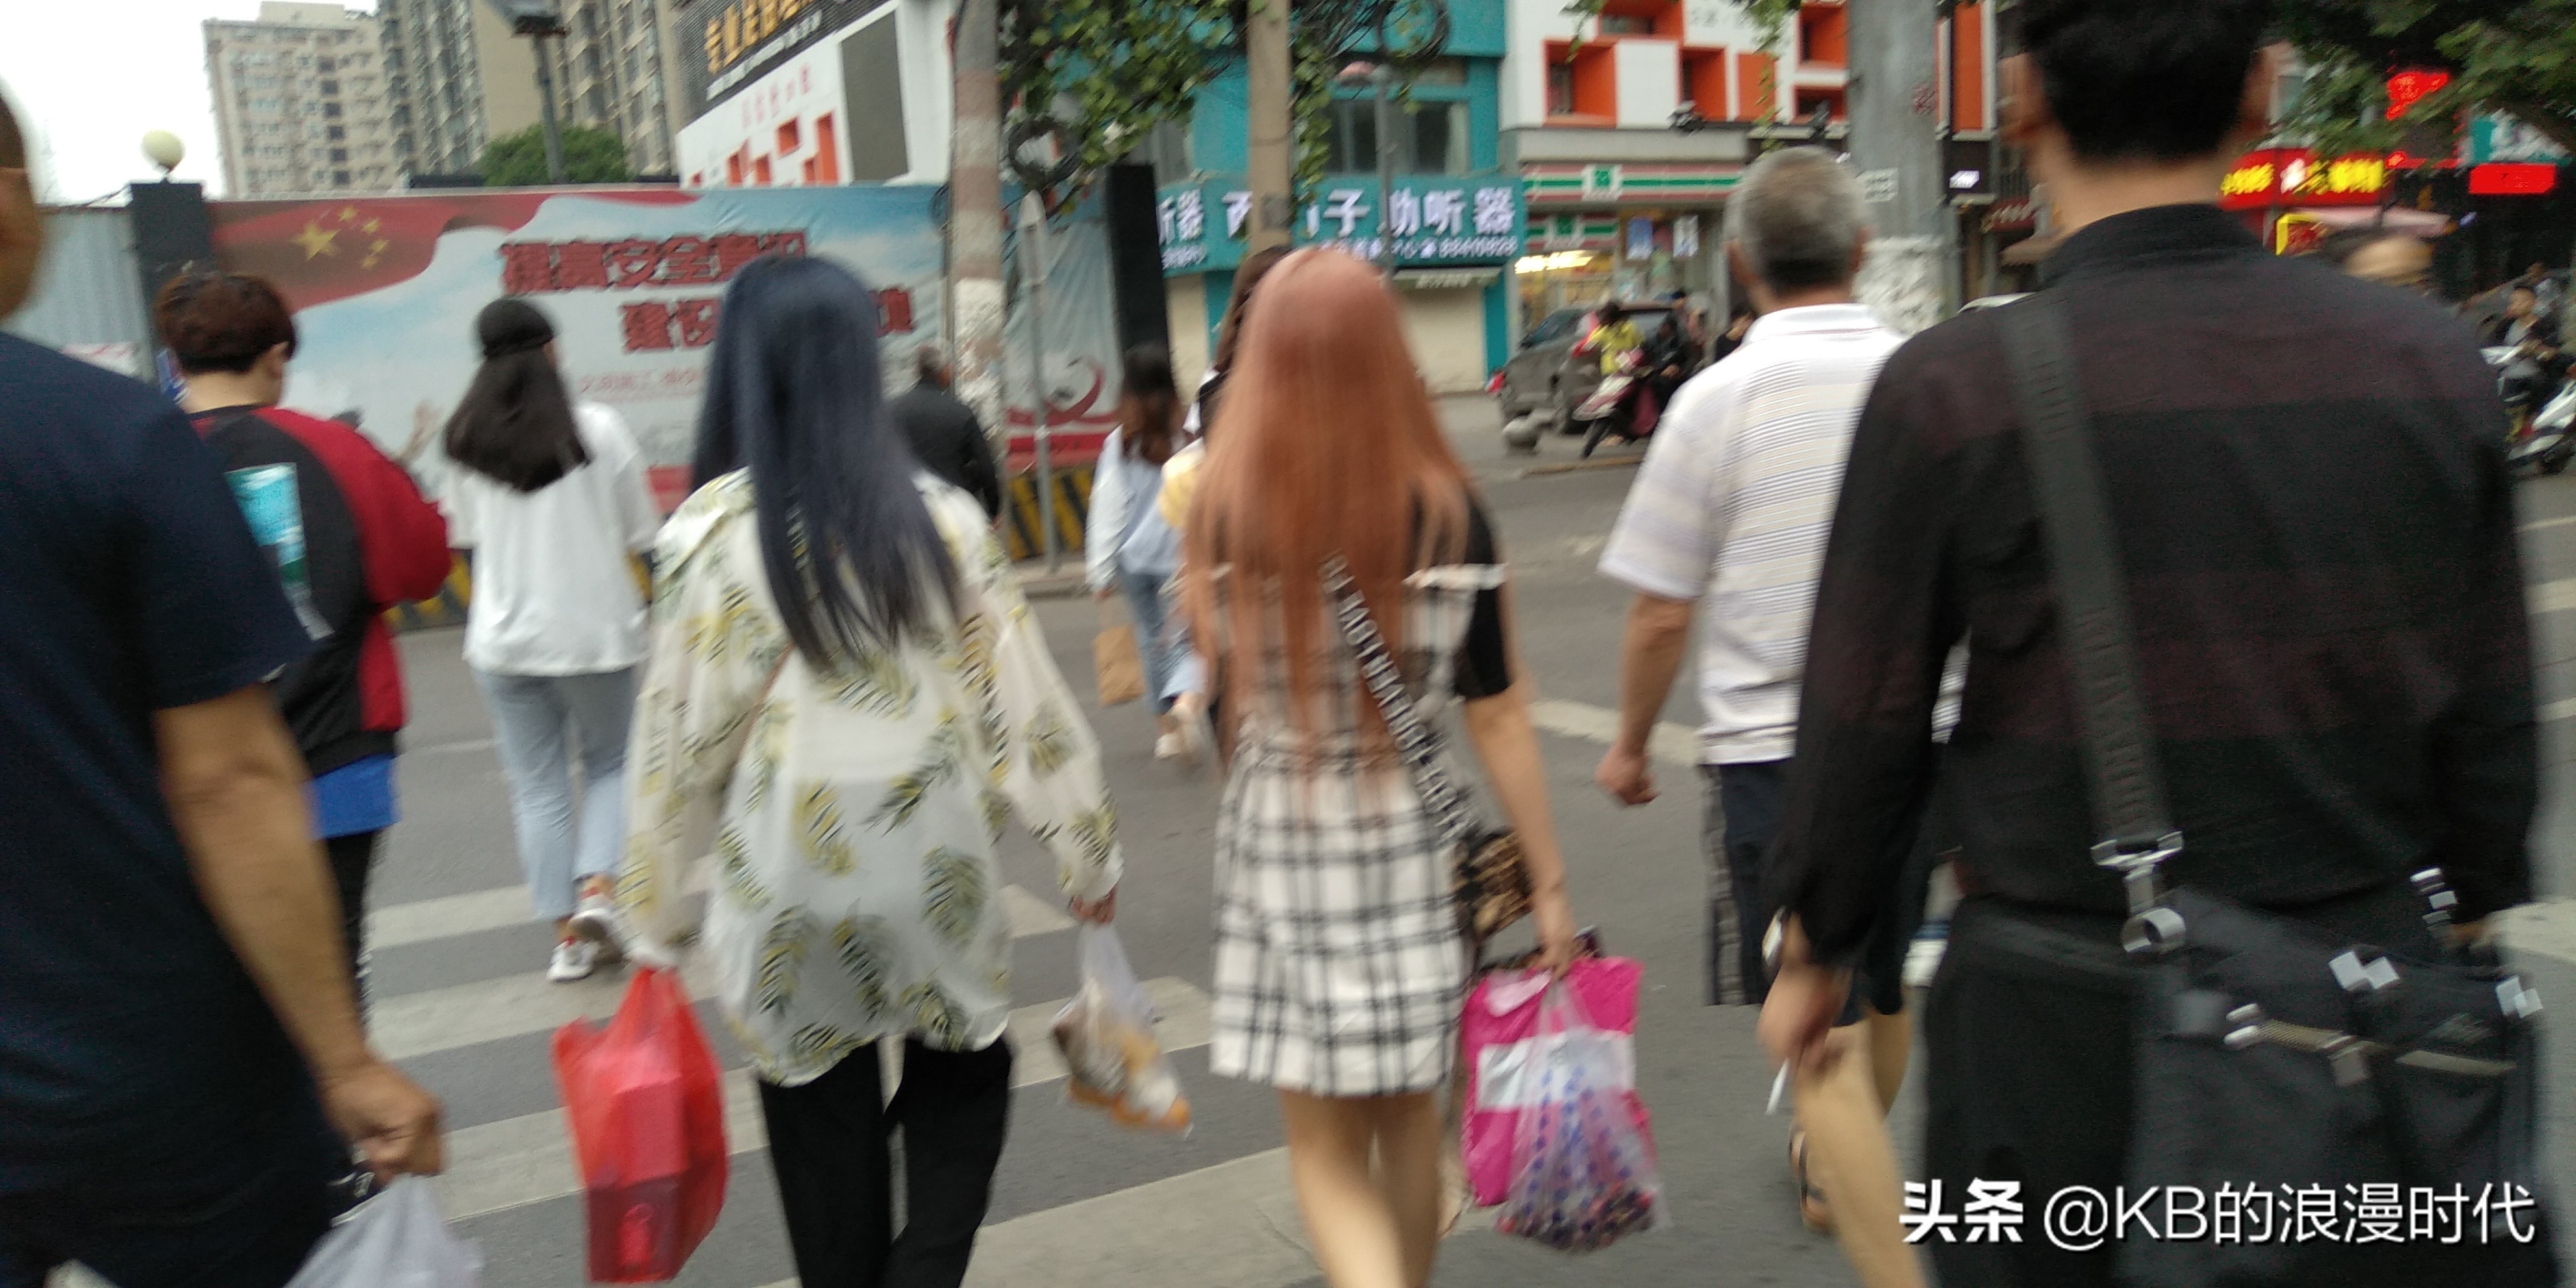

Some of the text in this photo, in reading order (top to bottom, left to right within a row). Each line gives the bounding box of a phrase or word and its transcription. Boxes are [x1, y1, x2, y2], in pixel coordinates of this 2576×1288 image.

[1221, 186, 1515, 239] 西子助听器
[1338, 589, 1385, 660] LOVE
